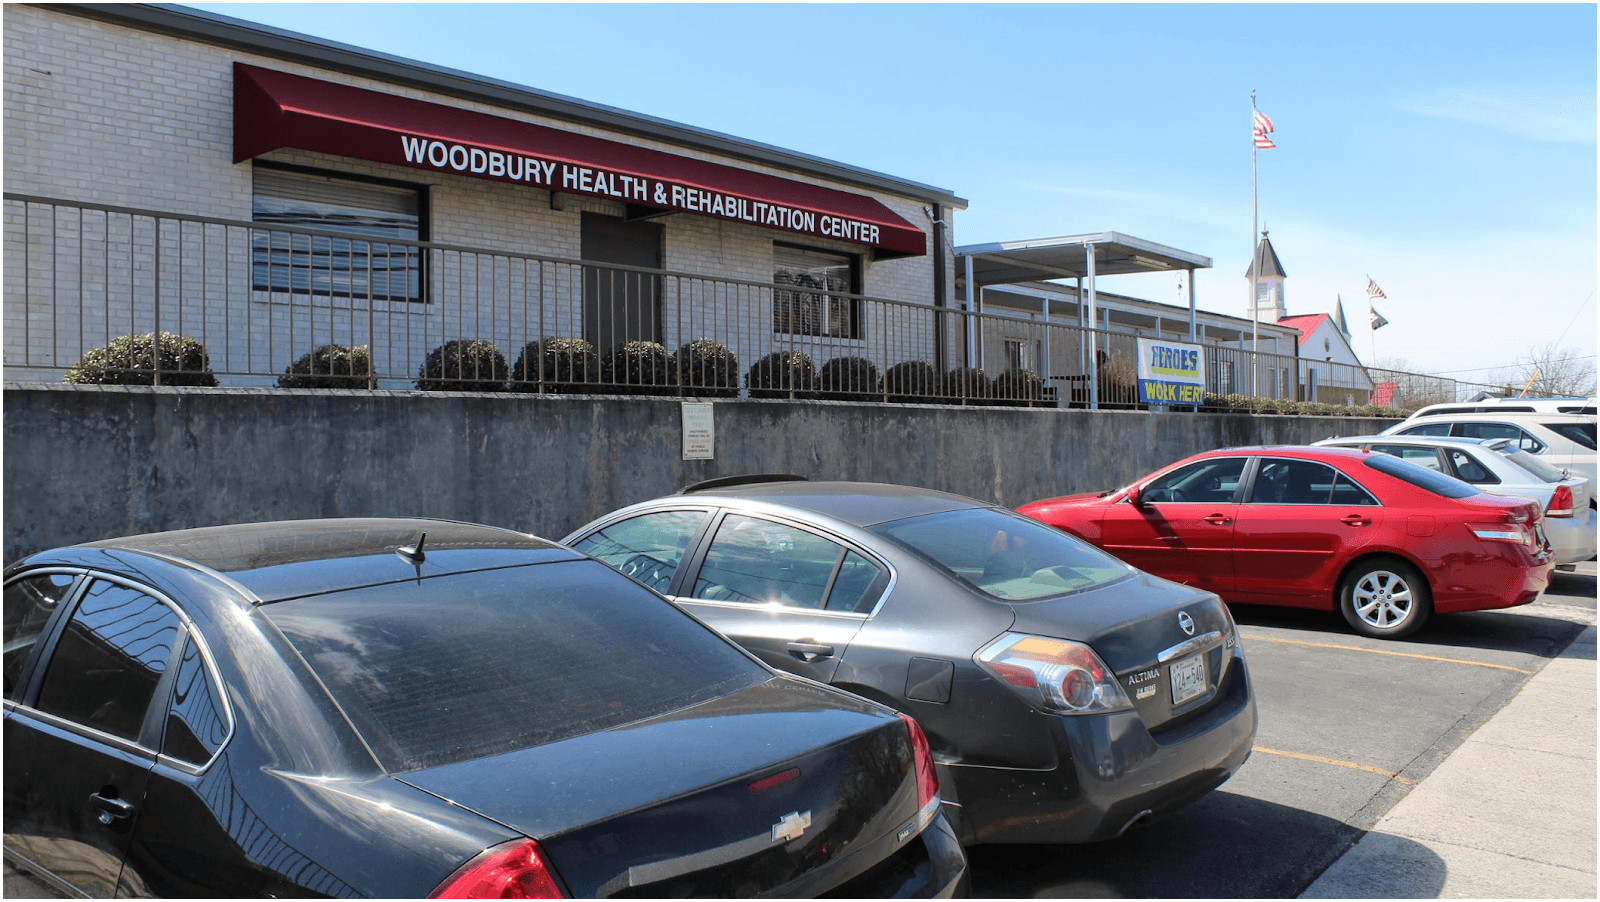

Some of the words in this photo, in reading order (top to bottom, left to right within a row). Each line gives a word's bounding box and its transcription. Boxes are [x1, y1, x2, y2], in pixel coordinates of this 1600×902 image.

[401, 135, 556, 185] WOODBURY
[562, 164, 648, 201] HEALTH
[653, 182, 668, 205] &
[672, 185, 815, 232] REHABILITATION
[820, 215, 880, 244] CENTER
[1145, 382, 1176, 401] WORK
[1128, 668, 1160, 686] ALTIMA
